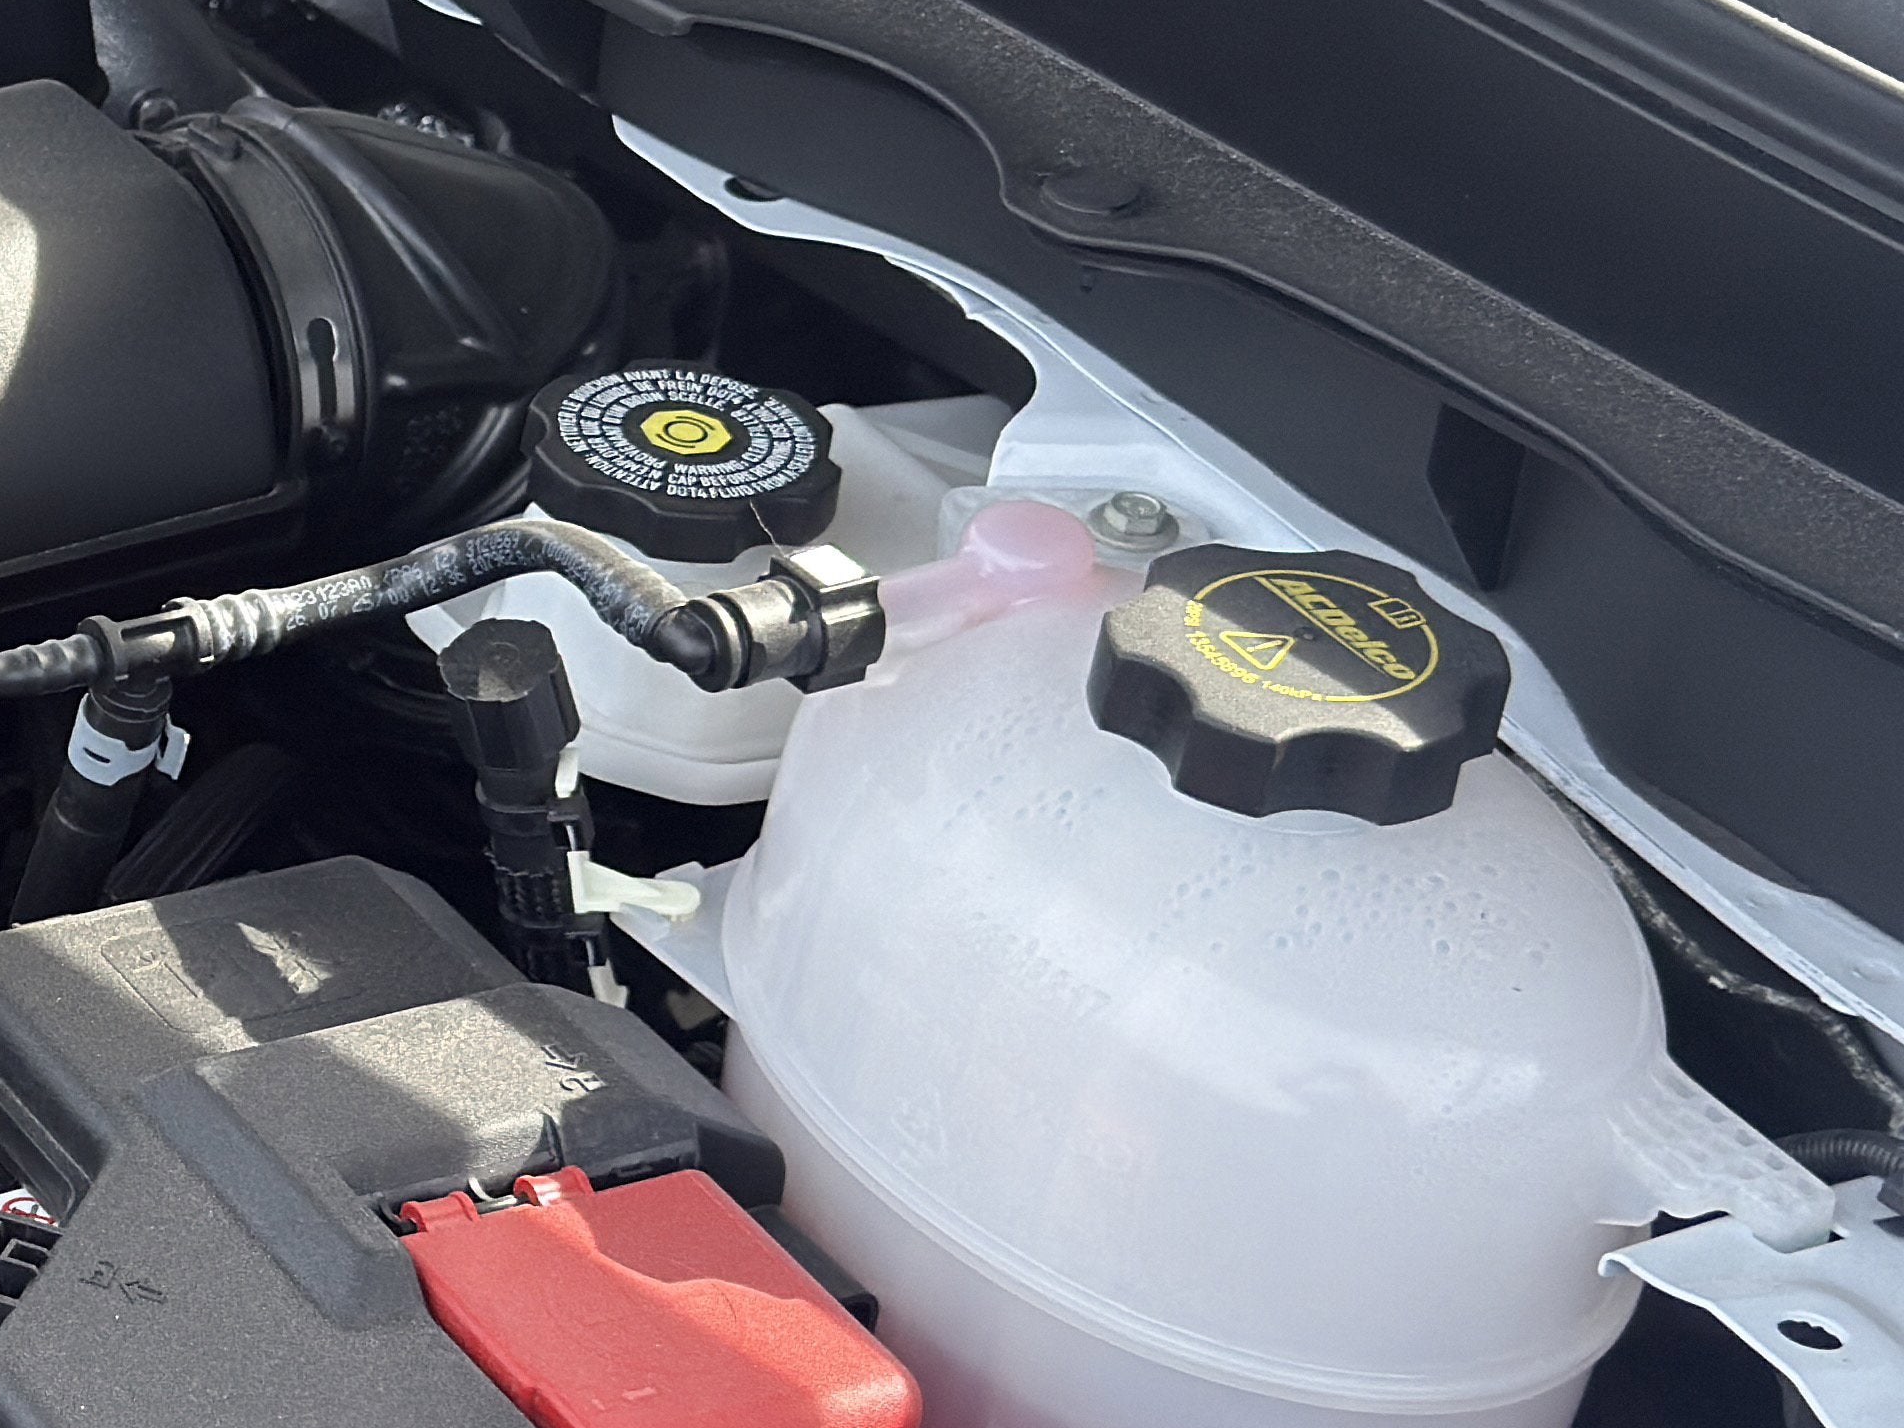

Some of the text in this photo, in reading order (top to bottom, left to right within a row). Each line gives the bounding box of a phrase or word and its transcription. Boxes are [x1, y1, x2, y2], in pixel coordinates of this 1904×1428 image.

[620, 368, 670, 381] AVANT
[630, 378, 655, 393] DE
[655, 379, 703, 393] FREIN
[705, 385, 747, 405] DOT4
[674, 370, 695, 382] LA
[557, 398, 584, 412] LE
[557, 410, 590, 453] NETTOYER
[601, 424, 667, 469] PROVENANT
[665, 400, 789, 487] CAP BEFORE USE ONLY
[727, 407, 770, 463] CLEAN FILLER
[579, 451, 662, 491] ATTENTION:
[664, 484, 708, 498] DOT4
[707, 483, 757, 498] FLUID
[749, 472, 795, 493] FROM
[783, 442, 815, 473] SEALED
[1270, 578, 1417, 680] ACDelco
[1262, 680, 1322, 701] 140kPa
